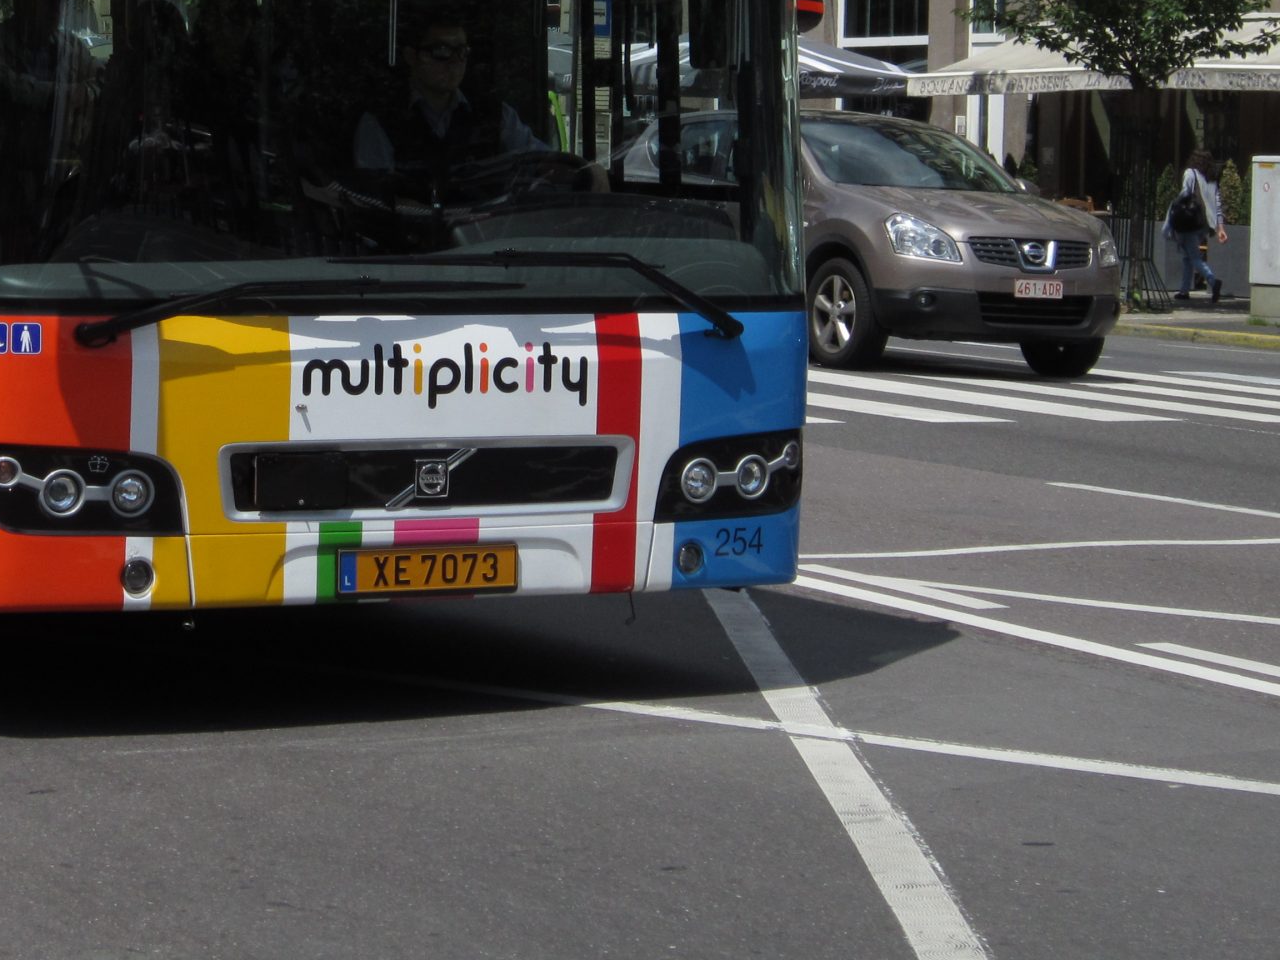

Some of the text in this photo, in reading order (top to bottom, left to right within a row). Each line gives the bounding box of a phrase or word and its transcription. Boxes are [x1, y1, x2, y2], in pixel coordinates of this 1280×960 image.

[302, 342, 589, 410] multiplicity
[714, 526, 764, 557] 254
[344, 552, 498, 587] L XE 7073
